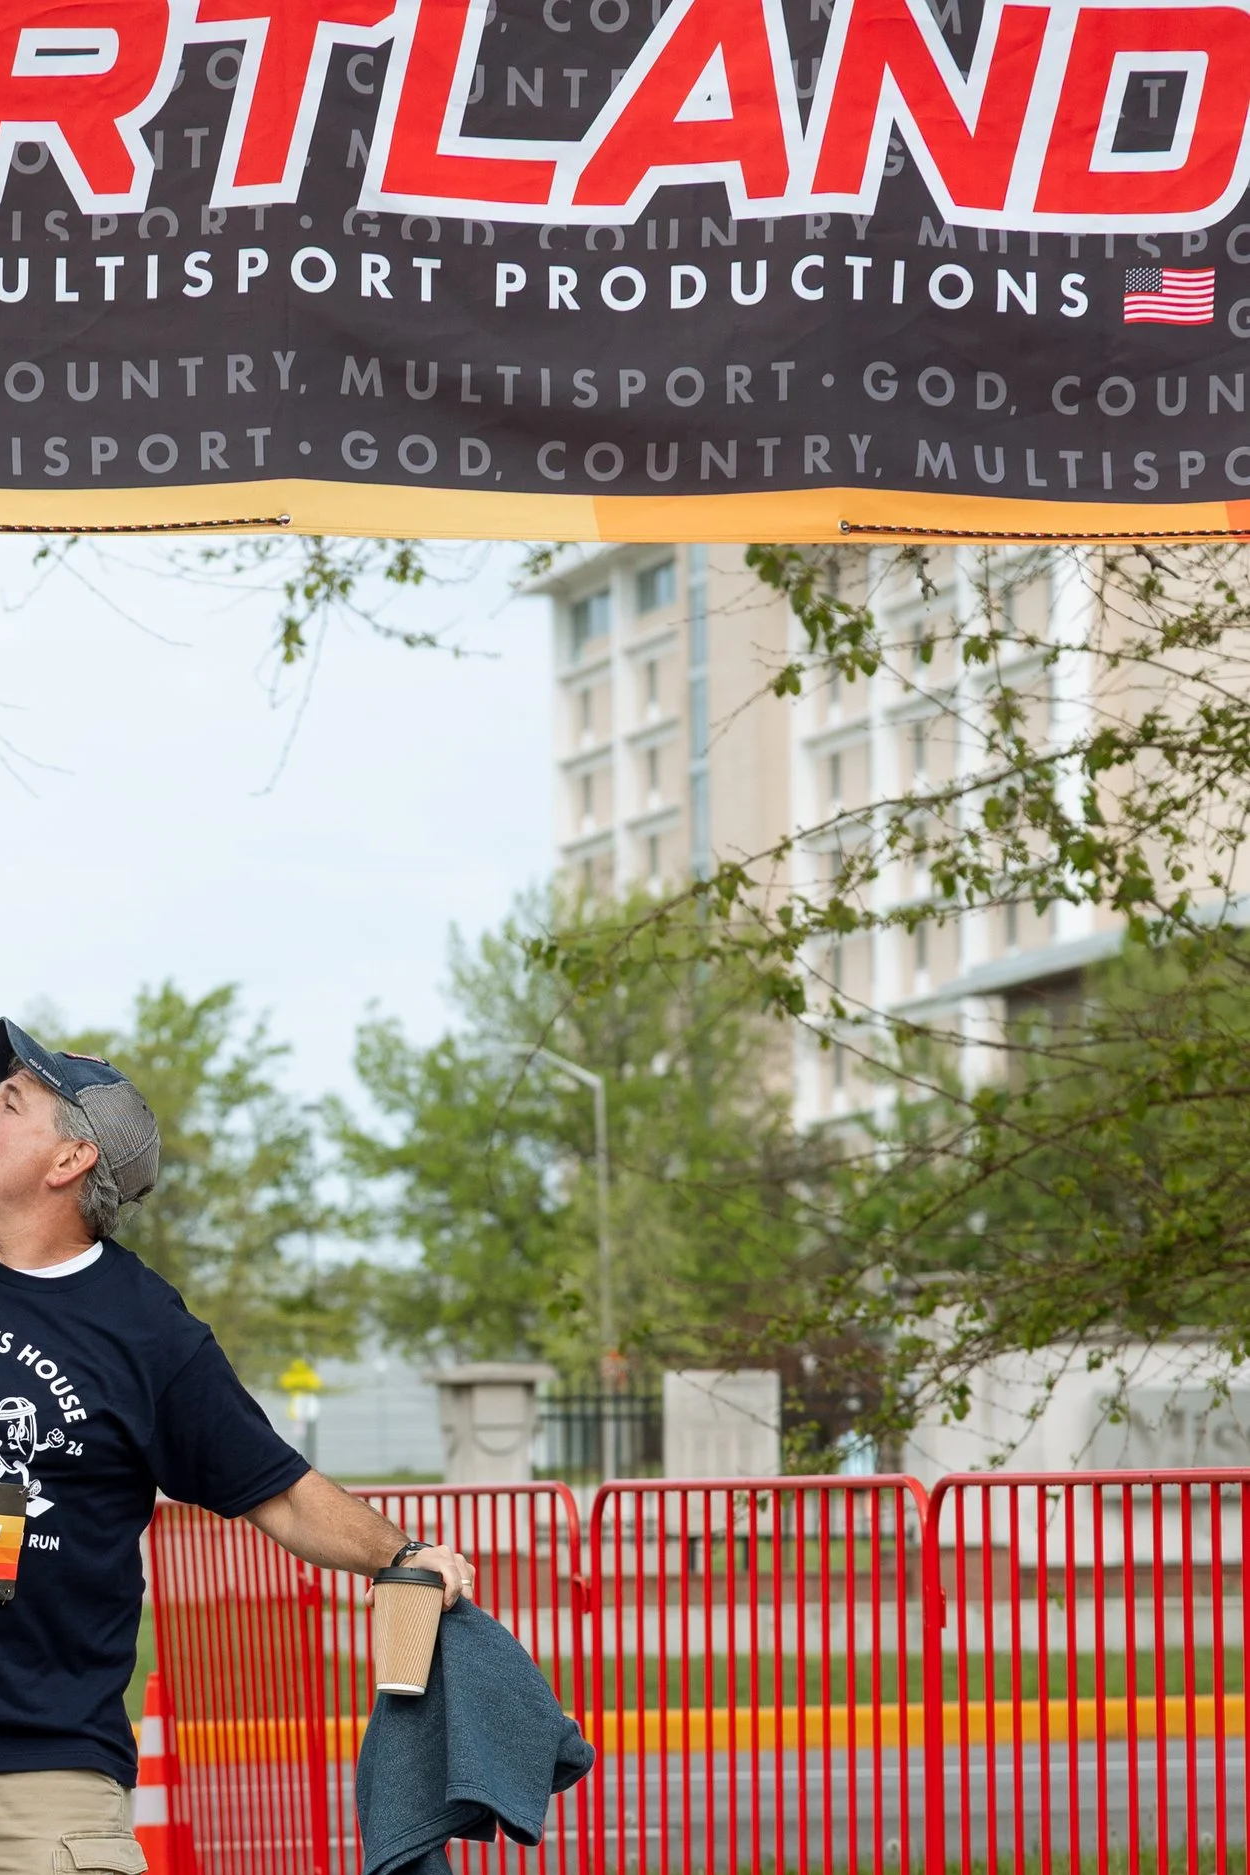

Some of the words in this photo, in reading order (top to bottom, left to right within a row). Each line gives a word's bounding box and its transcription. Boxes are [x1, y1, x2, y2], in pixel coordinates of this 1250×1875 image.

[495, 254, 1089, 318] PRODUCTIONS
[340, 355, 796, 409] MULTISPORT
[863, 361, 1018, 416] GOD,
[341, 430, 502, 481] GOD,
[537, 433, 882, 482] COUNTRY,
[16, 1343, 88, 1424] HOUSE
[65, 1441, 84, 1456] 26
[28, 1533, 60, 1551] RUN
